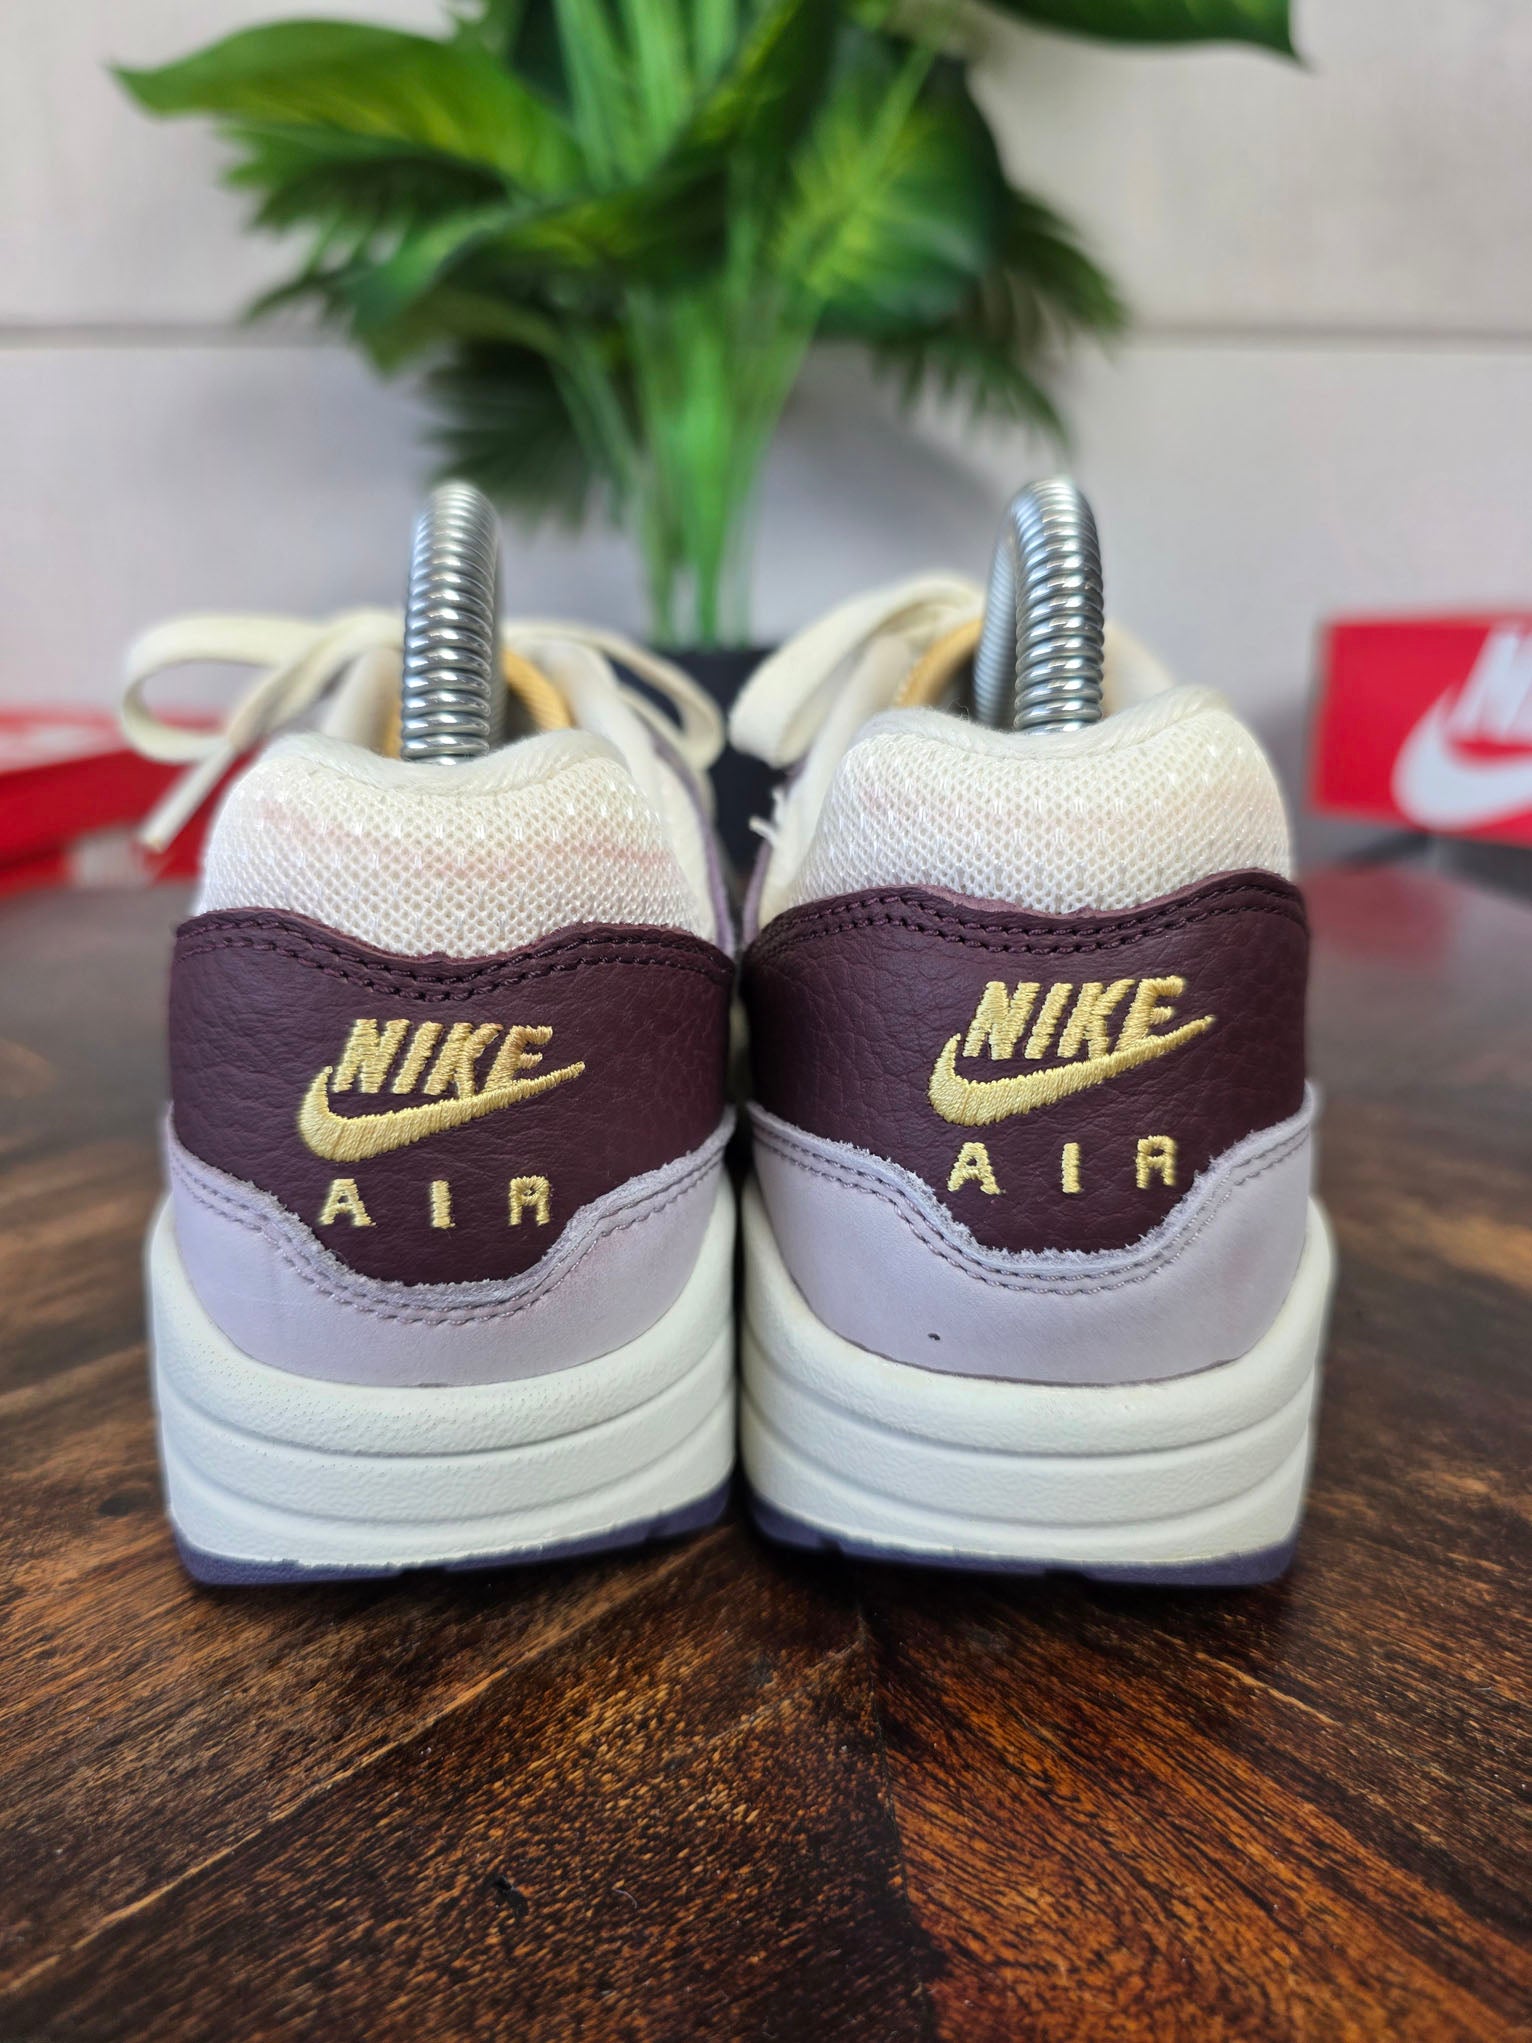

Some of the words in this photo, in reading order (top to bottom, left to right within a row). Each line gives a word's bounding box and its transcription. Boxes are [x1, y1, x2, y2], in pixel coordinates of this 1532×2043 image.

[963, 975, 1186, 1060] NIKE
[332, 1018, 553, 1100] NIKE
[947, 1135, 1178, 1195] AIR
[317, 1175, 553, 1229] AIR
